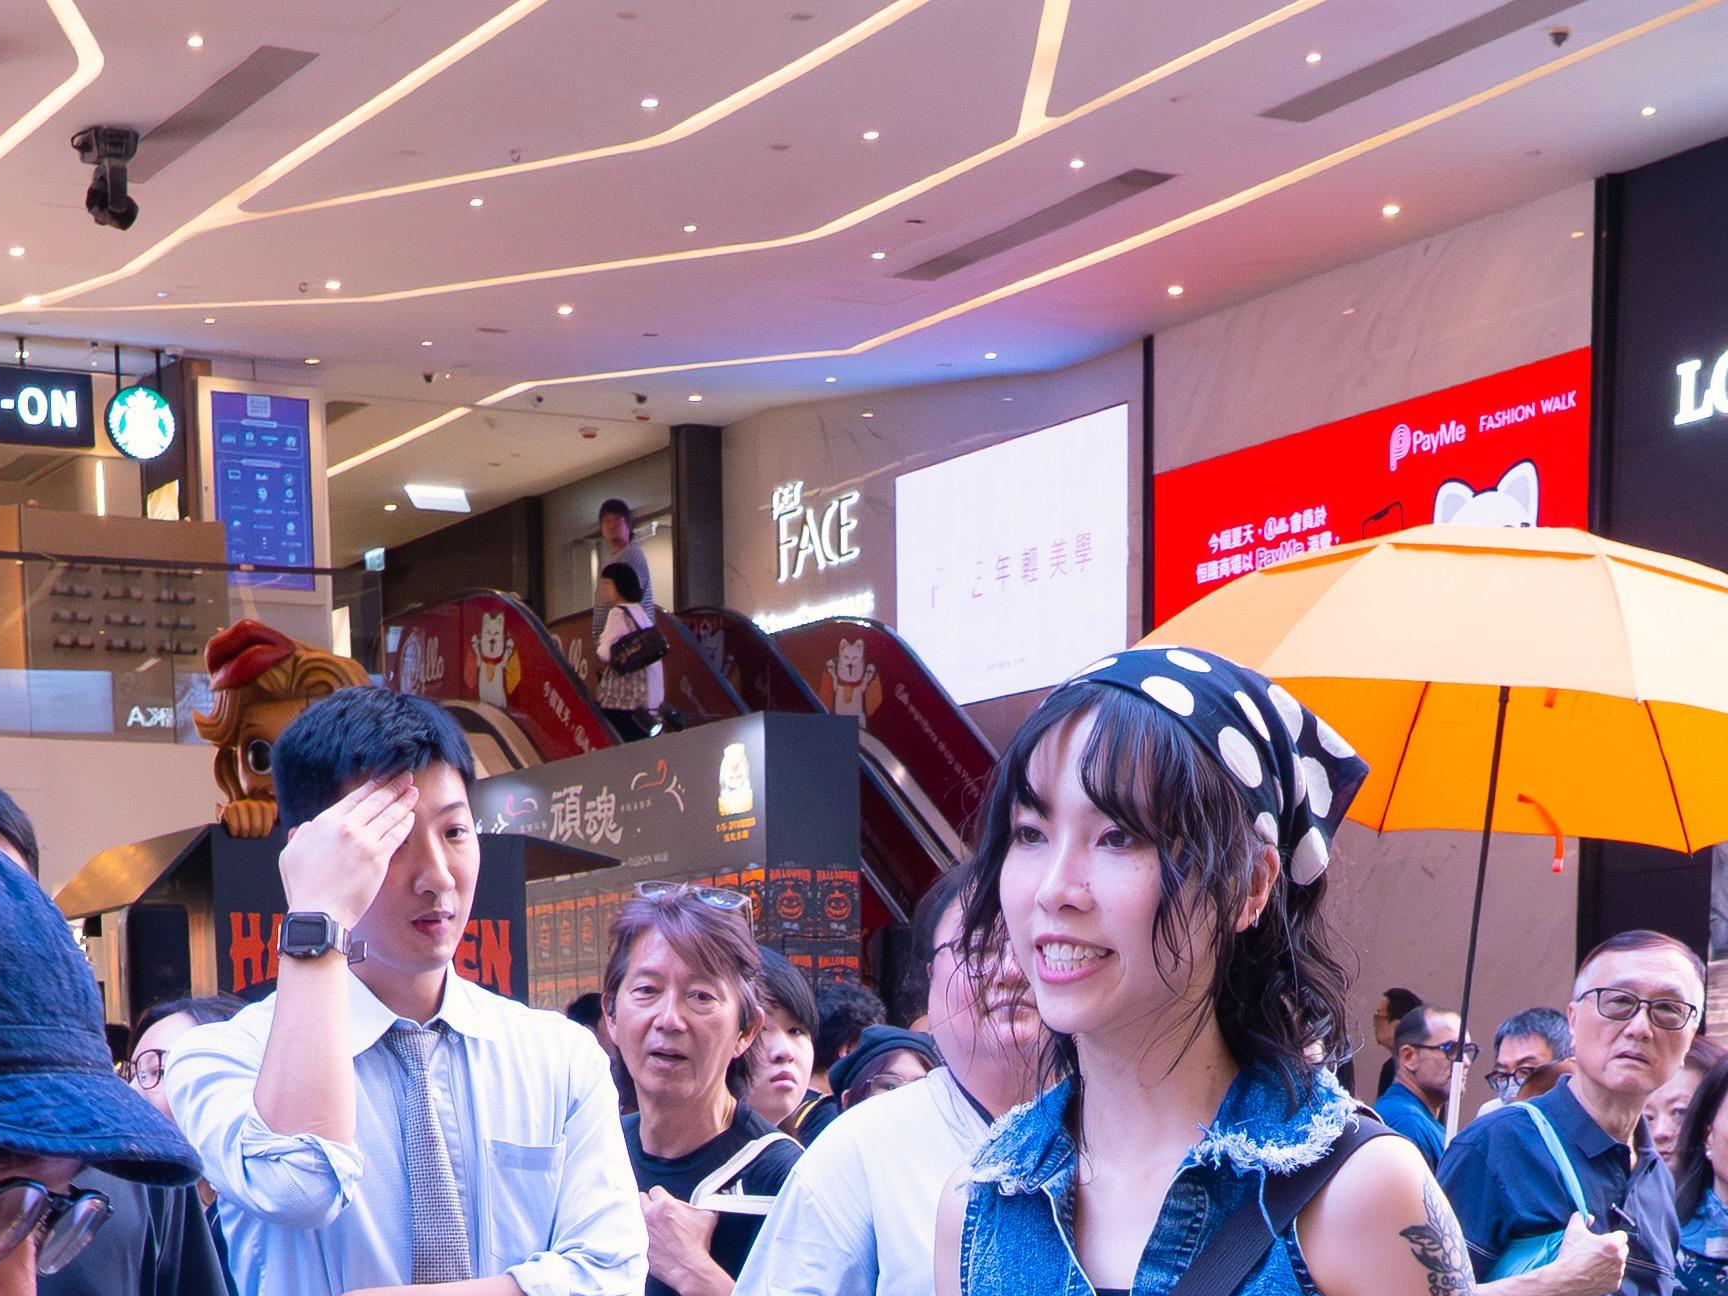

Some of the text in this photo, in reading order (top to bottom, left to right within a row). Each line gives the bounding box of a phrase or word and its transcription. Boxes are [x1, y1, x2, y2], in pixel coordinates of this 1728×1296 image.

[1478, 390, 1577, 433] FASHION WALK
[1412, 420, 1466, 454] PayMe
[777, 490, 861, 583] FACE
